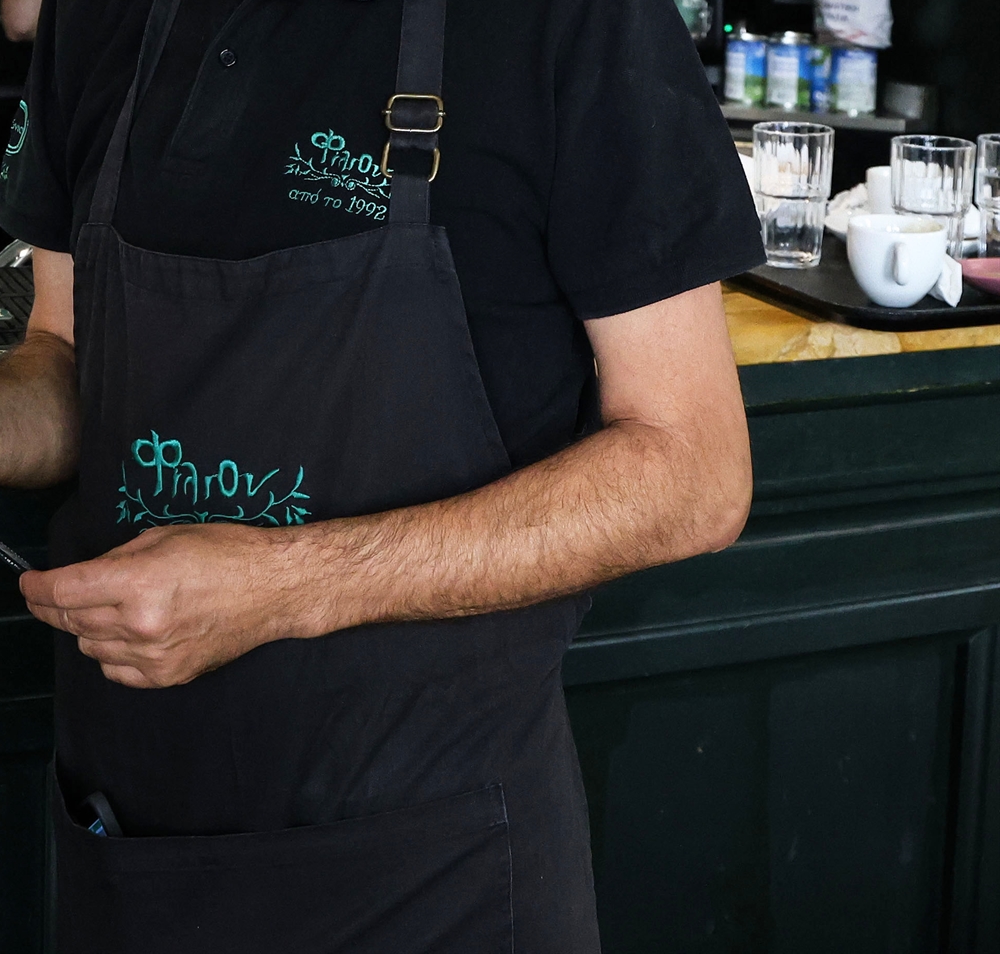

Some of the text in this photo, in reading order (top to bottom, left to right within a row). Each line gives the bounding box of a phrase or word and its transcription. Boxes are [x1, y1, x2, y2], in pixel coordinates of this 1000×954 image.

[289, 188, 387, 221] από το 1992
